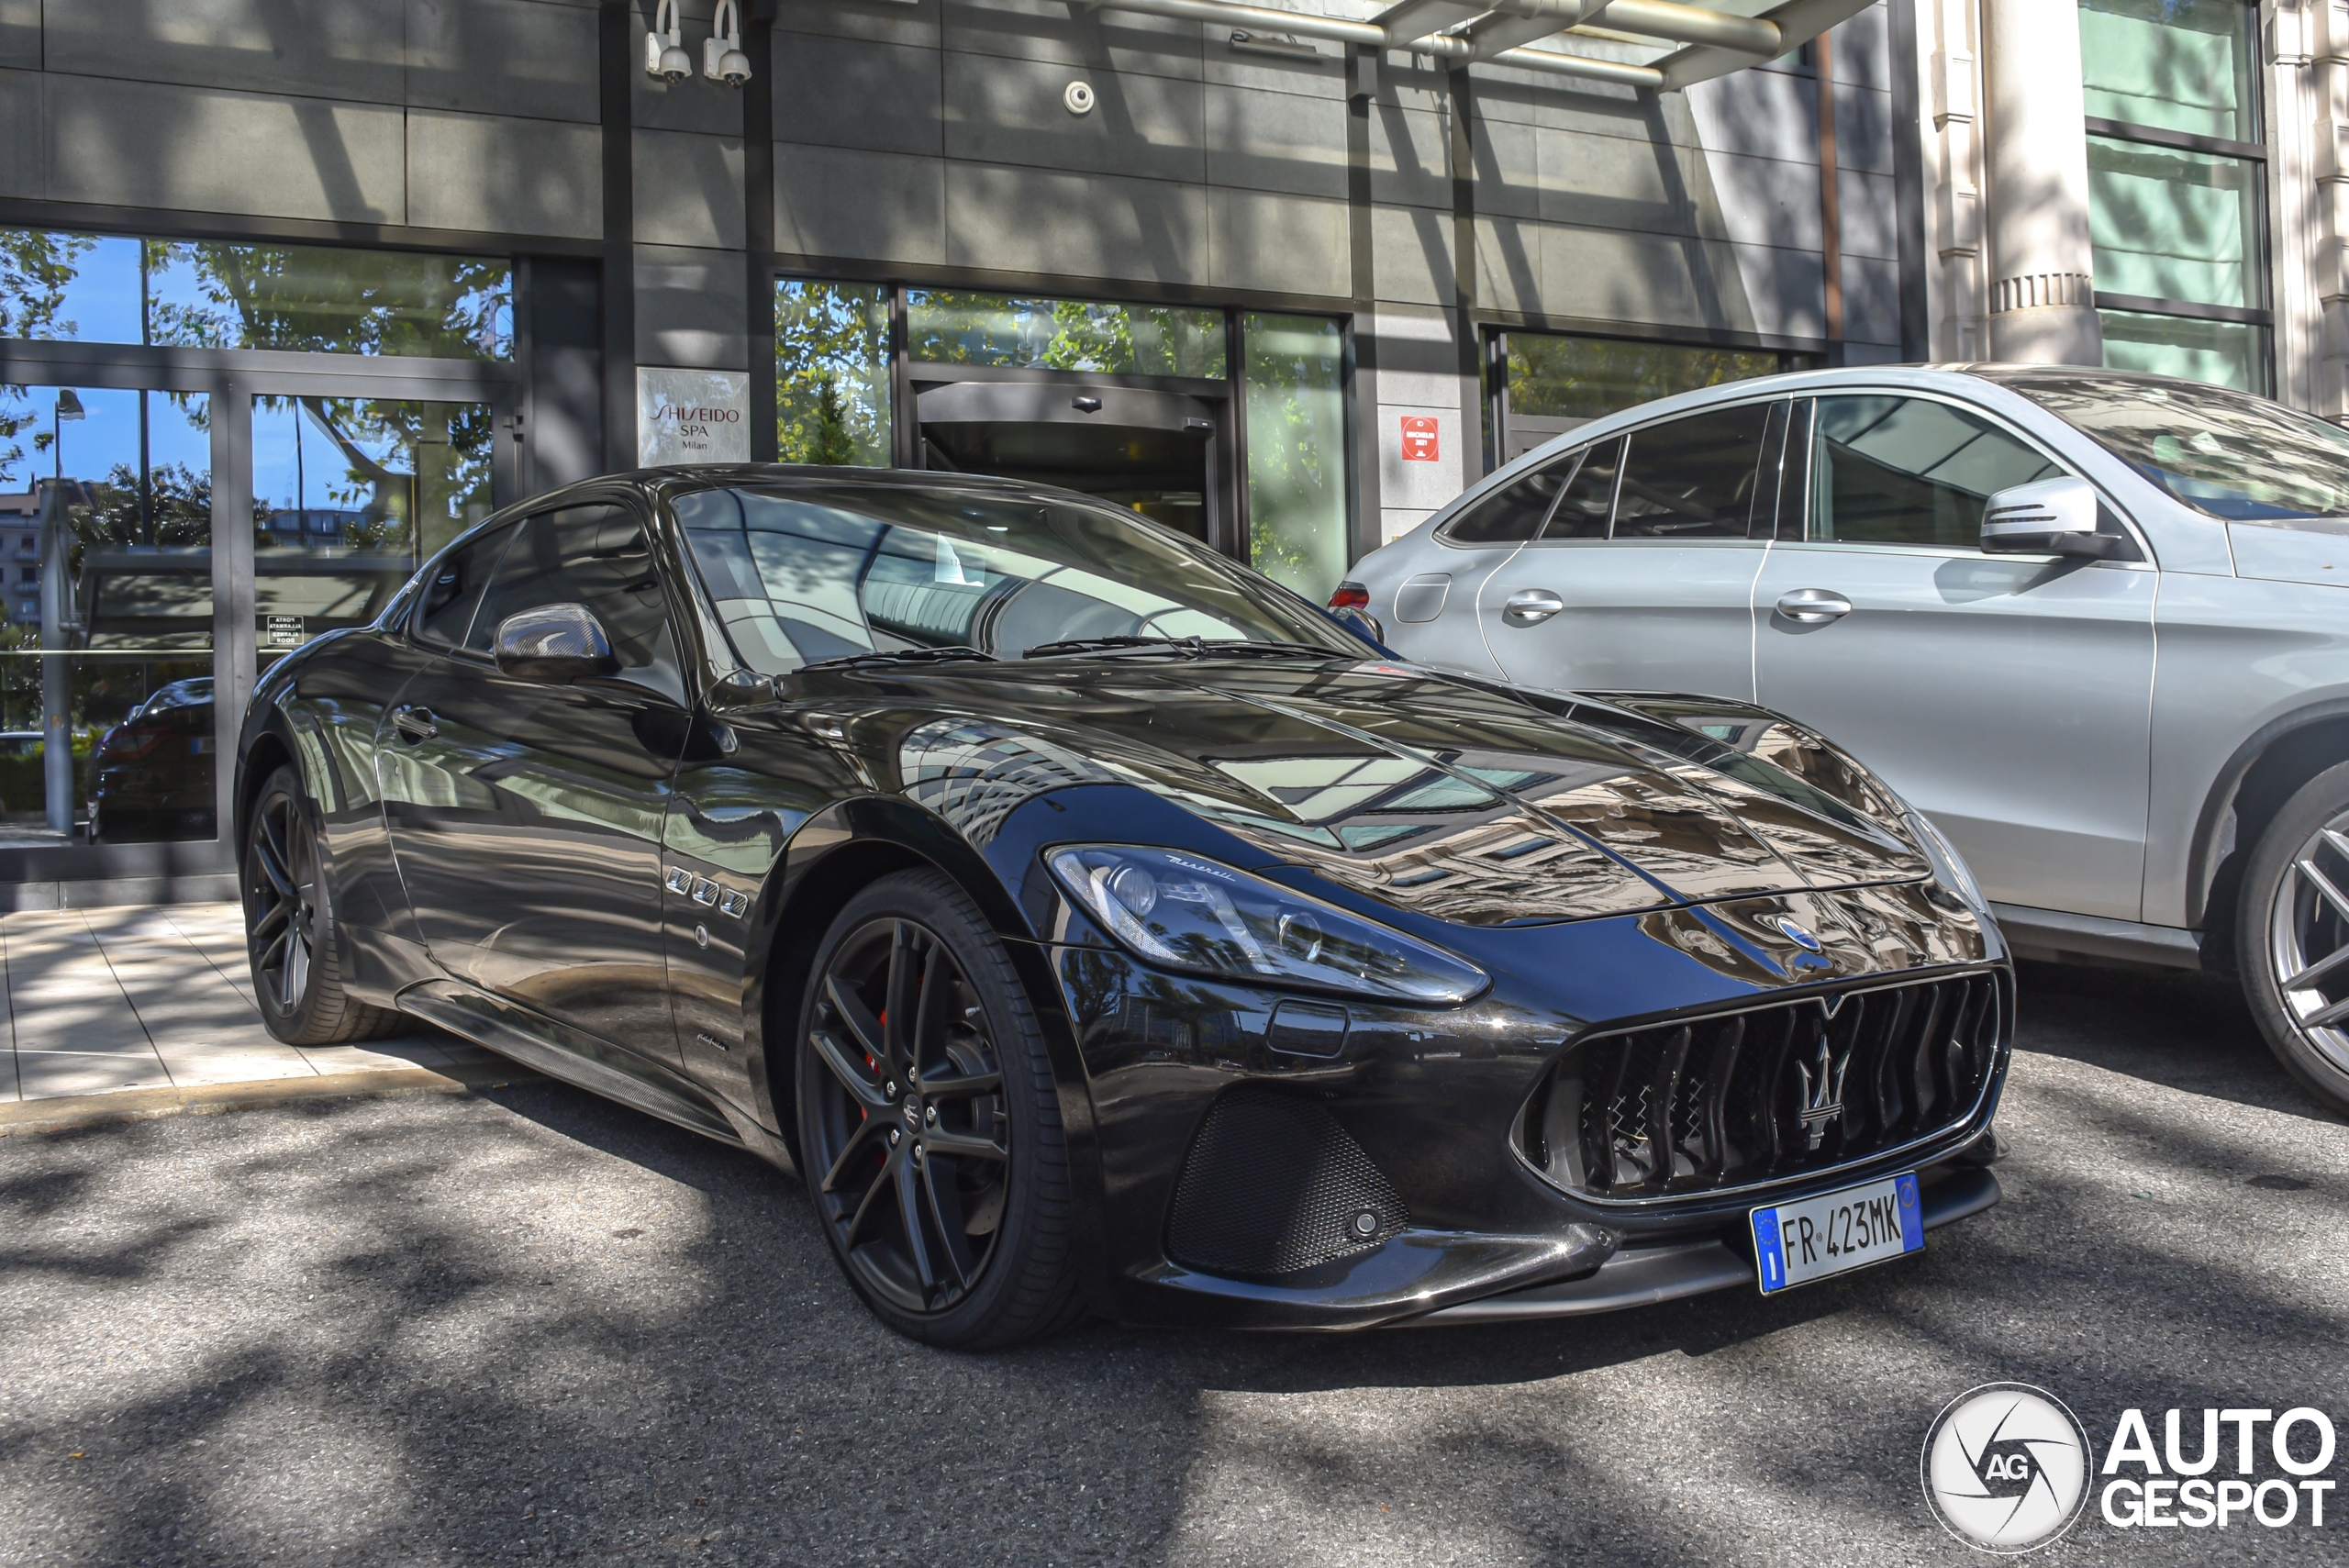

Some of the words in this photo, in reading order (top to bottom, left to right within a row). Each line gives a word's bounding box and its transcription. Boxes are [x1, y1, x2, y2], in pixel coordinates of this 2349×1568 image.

[649, 404, 740, 423] SHISEIDO
[680, 425, 709, 437] SPA
[682, 440, 707, 450] Milan
[1782, 1217, 1817, 1270] FR
[1826, 1194, 1901, 1257] 423MK
[1768, 1251, 1776, 1281] I
